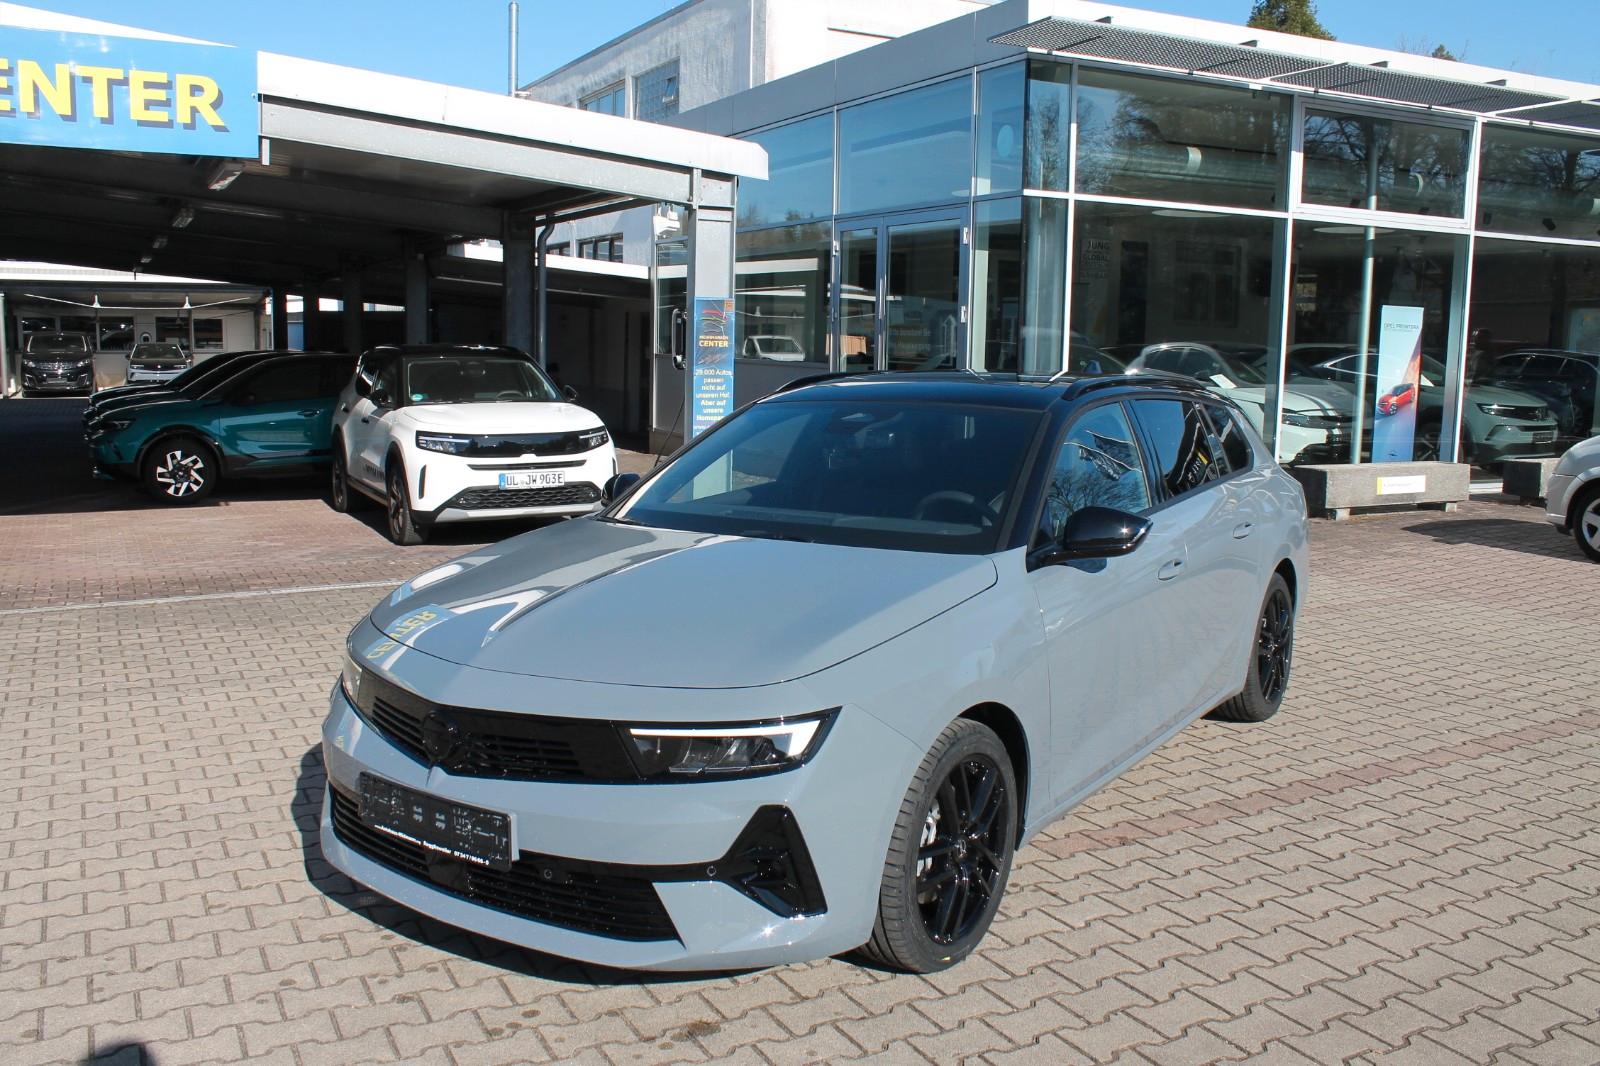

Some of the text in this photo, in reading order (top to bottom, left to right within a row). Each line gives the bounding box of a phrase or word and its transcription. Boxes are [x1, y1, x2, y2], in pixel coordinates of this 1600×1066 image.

[0, 58, 228, 131] NTER
[699, 340, 729, 348] CENTER
[506, 473, 564, 486] UL JW 903E
